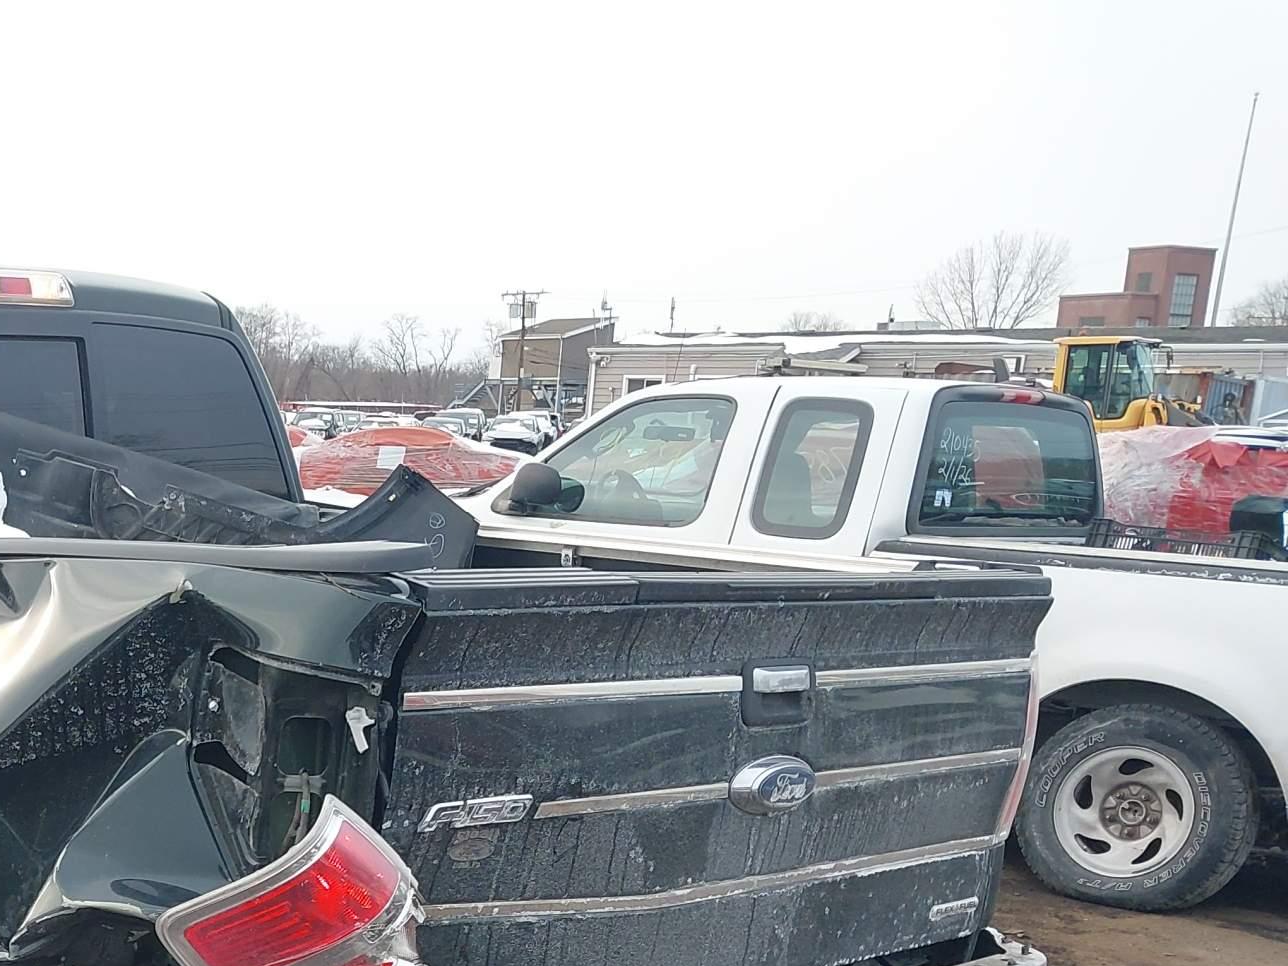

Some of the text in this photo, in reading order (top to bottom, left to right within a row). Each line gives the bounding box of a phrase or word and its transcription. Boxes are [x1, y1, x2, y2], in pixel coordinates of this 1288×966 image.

[770, 773, 808, 803] Ford
[1035, 731, 1105, 807] COOPER
[1144, 771, 1212, 888] DISCOVERER
